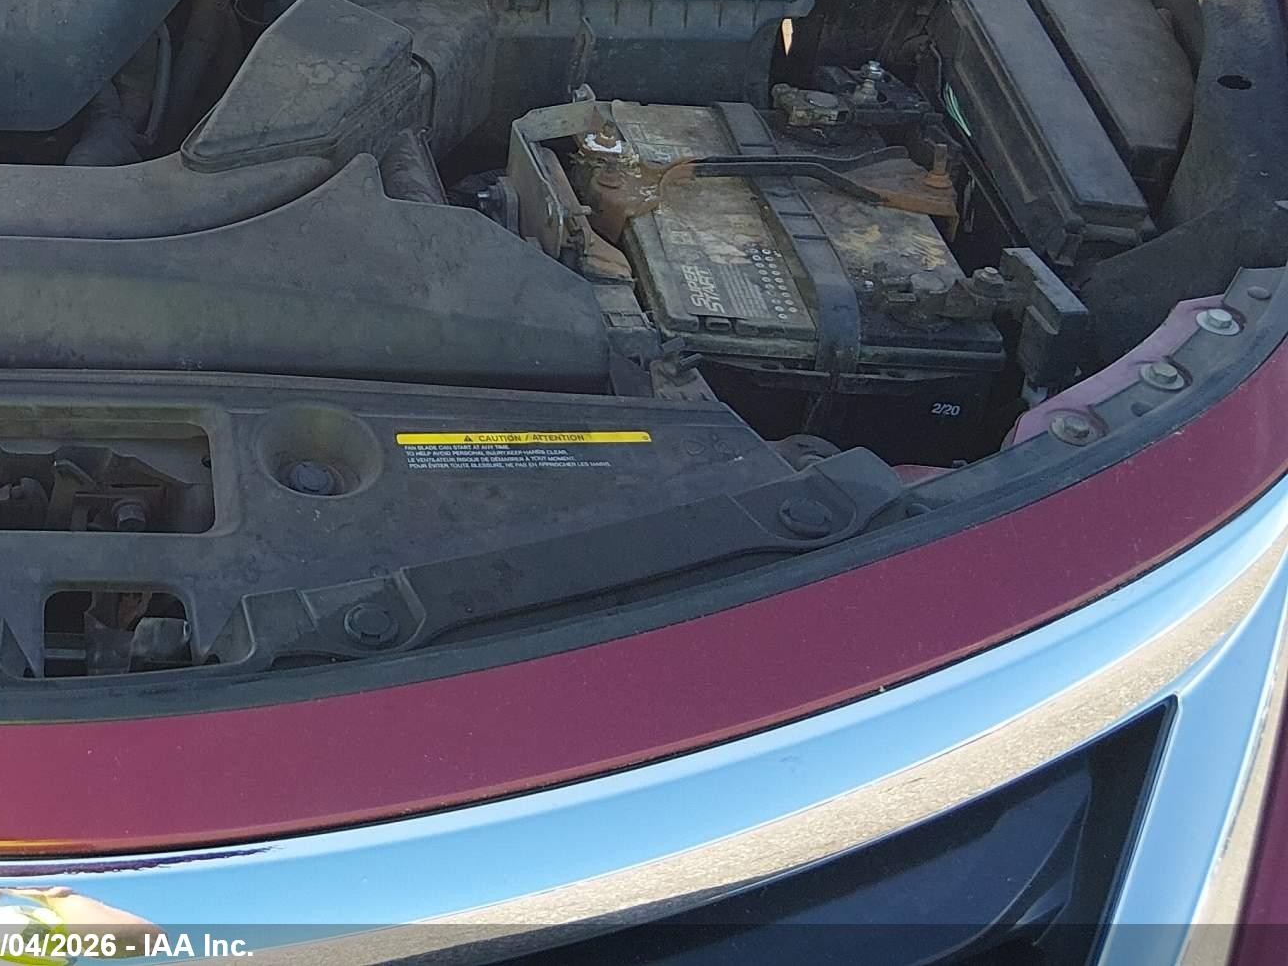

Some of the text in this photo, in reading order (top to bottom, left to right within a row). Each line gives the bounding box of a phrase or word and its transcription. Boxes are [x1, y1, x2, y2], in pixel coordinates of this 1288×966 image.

[681, 265, 706, 307] SUPER
[694, 265, 725, 314] START
[931, 402, 961, 416] 2/20
[478, 434, 522, 442] CAUTION
[532, 433, 585, 442] ATTENTION
